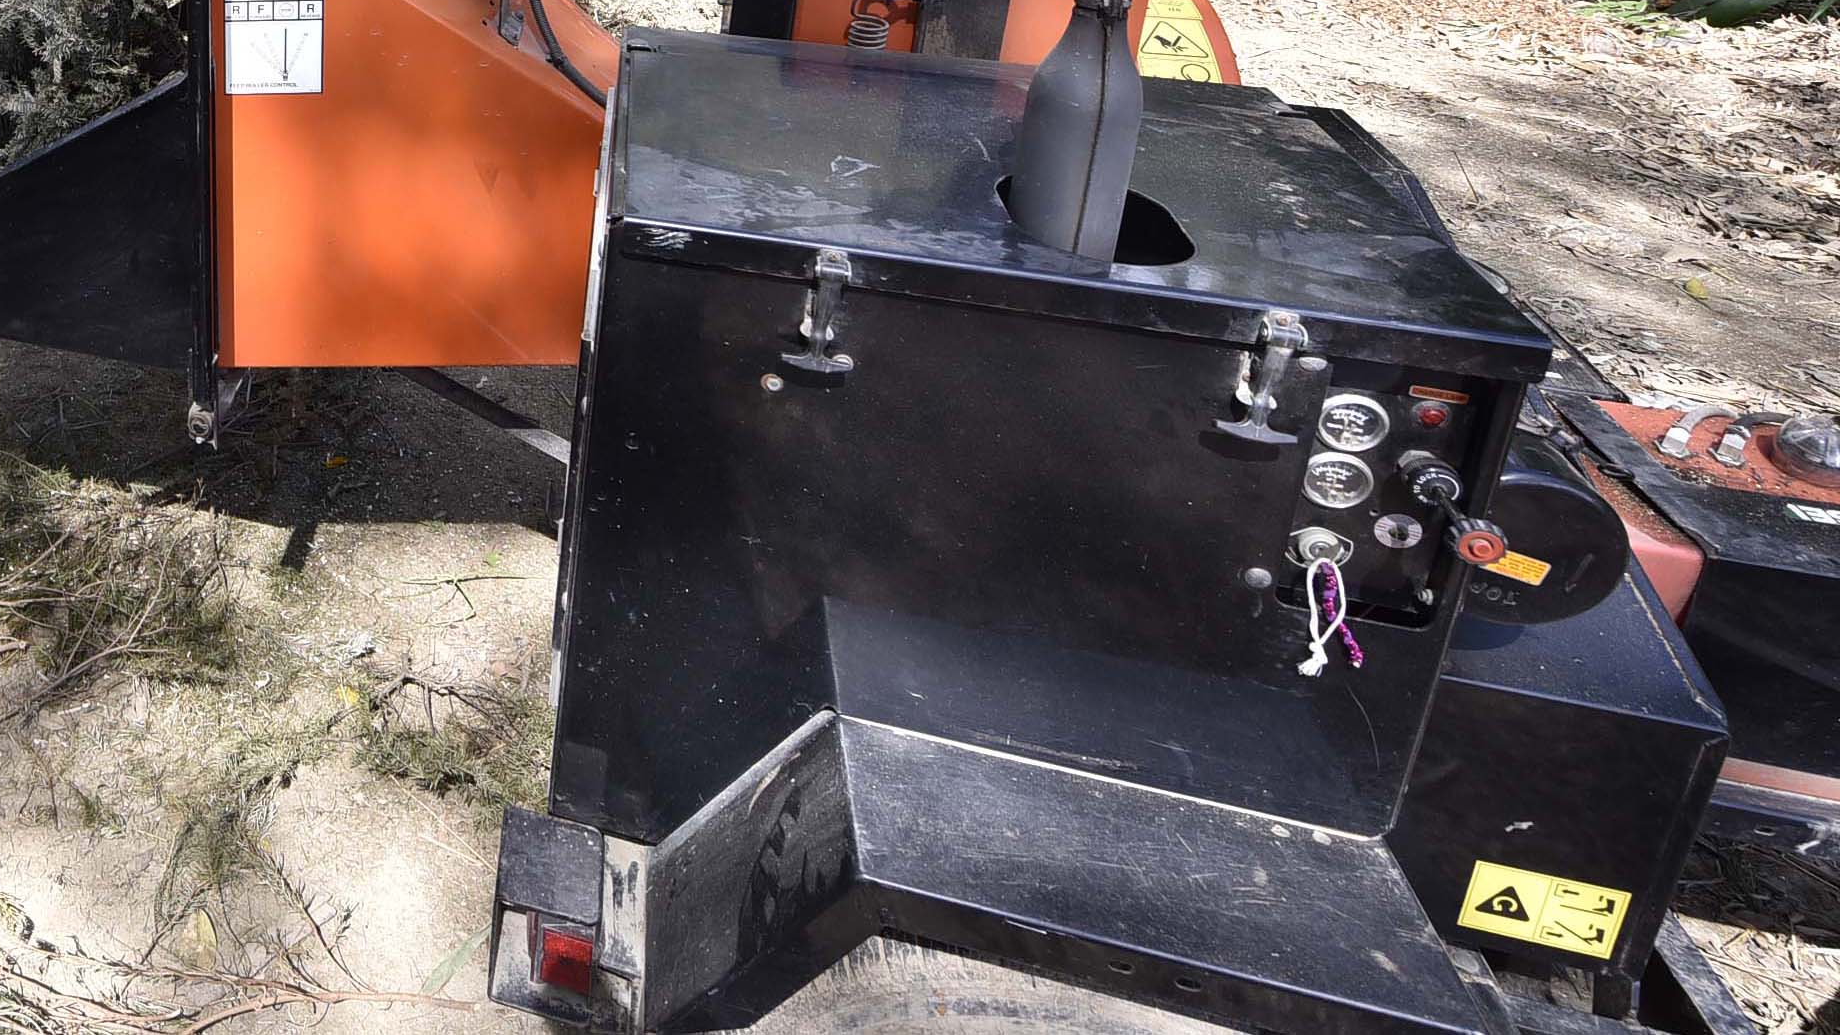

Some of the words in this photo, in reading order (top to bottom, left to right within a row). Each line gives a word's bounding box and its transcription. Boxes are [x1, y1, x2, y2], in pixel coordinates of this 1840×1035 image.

[232, 5, 240, 14] R
[257, 4, 265, 14] F
[306, 3, 315, 13] R
[1415, 472, 1438, 485] LOCK
